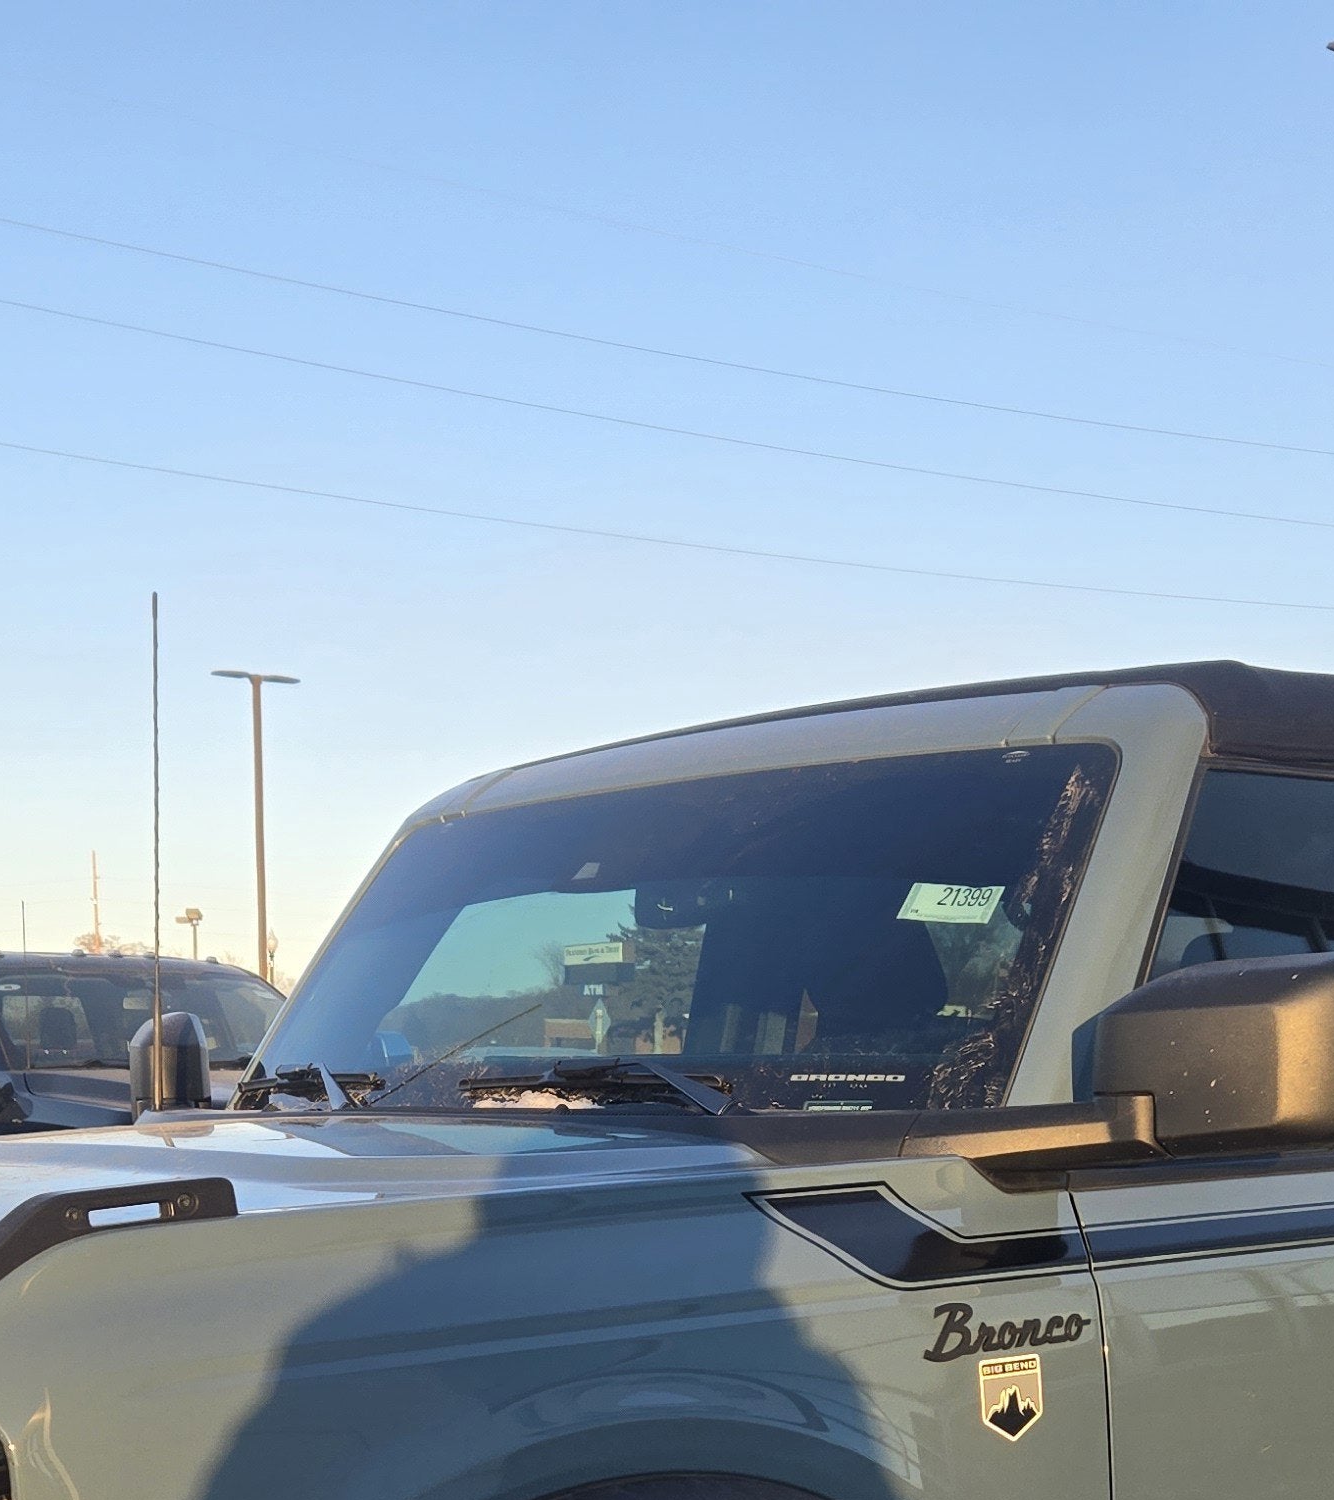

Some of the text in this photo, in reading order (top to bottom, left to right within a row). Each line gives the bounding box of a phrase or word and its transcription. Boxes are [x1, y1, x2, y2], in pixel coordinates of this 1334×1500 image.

[937, 886, 994, 907] 21399
[923, 1302, 1091, 1363] Bronco
[982, 1360, 1038, 1376] BIG BEND
